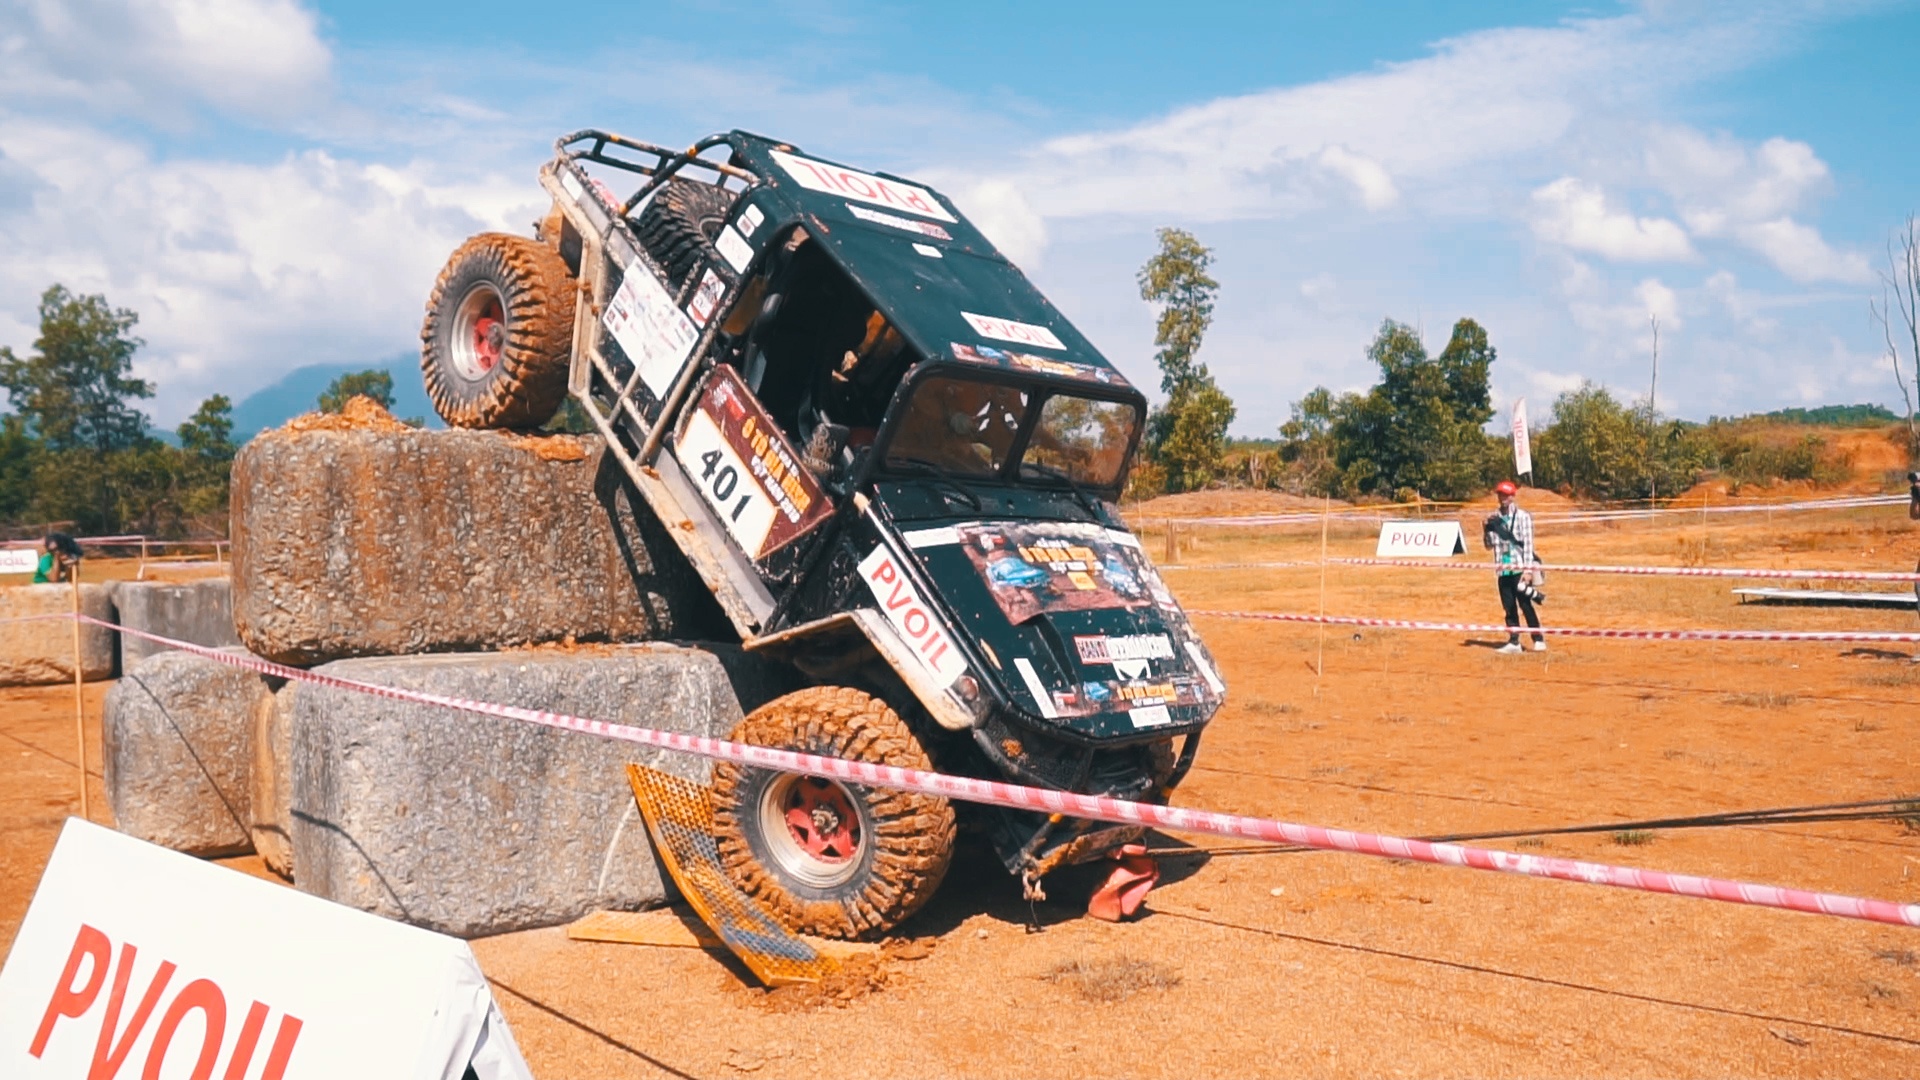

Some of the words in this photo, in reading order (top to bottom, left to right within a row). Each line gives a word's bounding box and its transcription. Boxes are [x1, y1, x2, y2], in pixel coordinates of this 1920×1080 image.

[794, 160, 934, 213] PVOIL
[976, 318, 1055, 345] PVOIL
[701, 450, 751, 524] 401
[1391, 532, 1440, 547] PVOIL
[871, 558, 948, 673] PVOIL
